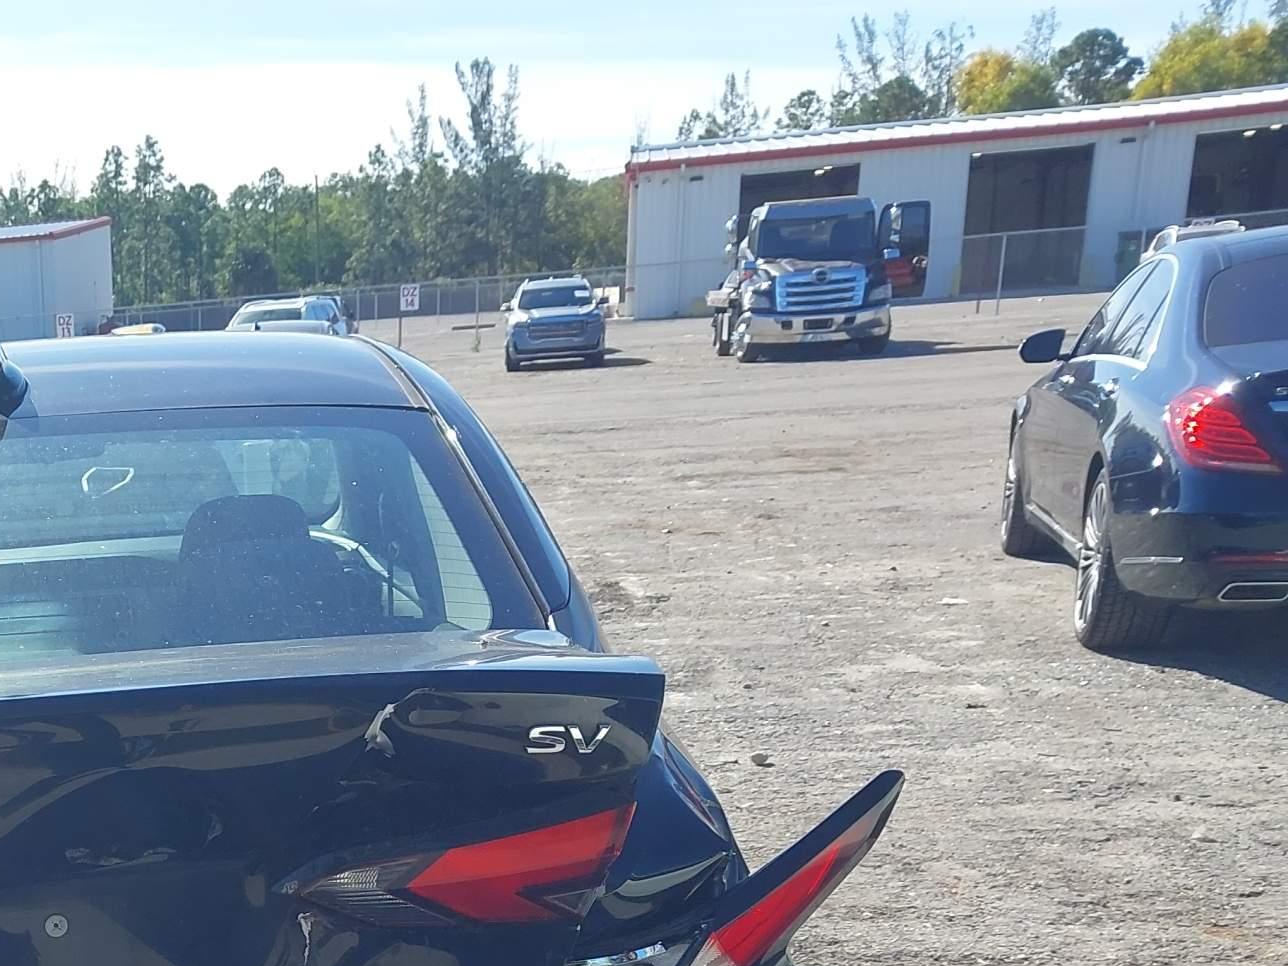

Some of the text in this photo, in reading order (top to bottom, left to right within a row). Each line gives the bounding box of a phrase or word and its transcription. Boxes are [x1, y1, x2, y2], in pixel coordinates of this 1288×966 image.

[402, 287, 417, 297] DZ
[405, 298, 415, 308] 14
[58, 315, 73, 326] DZ
[525, 724, 612, 754] SV
